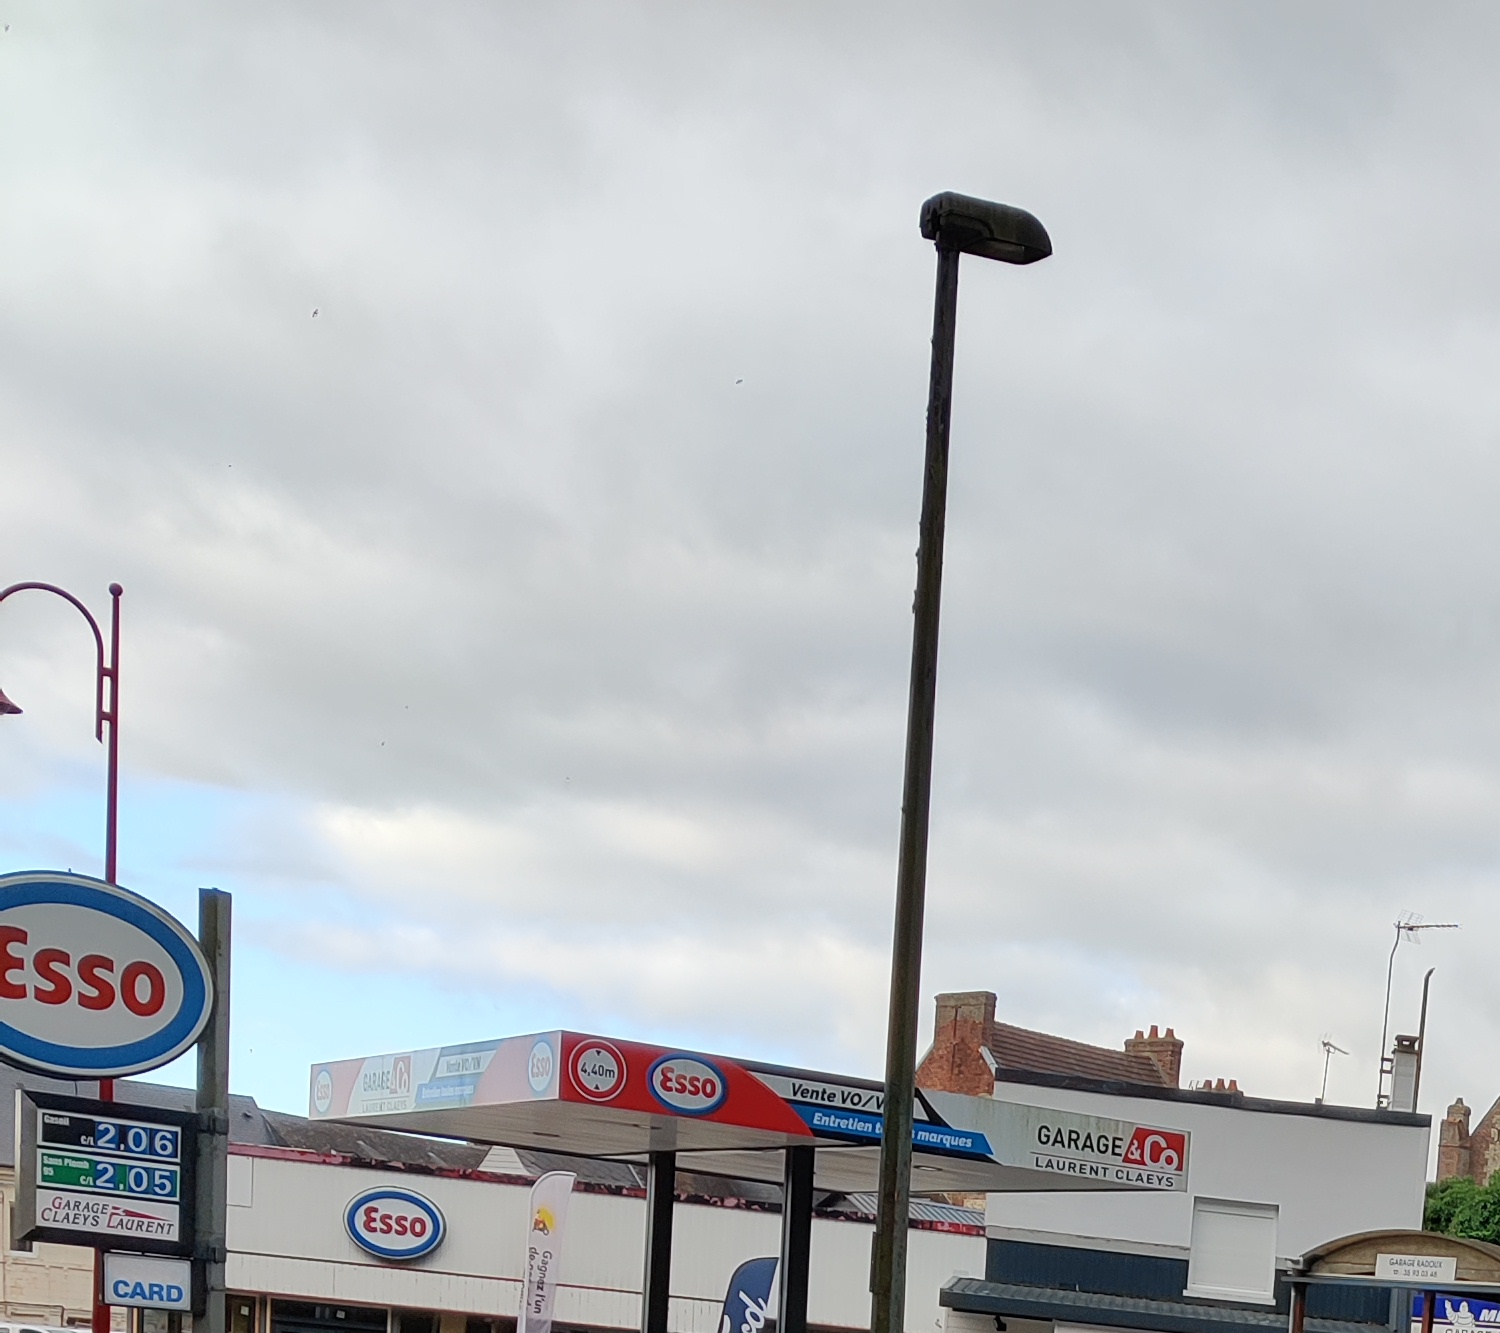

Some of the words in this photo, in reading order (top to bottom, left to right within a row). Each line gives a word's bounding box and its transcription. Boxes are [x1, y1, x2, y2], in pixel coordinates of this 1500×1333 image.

[580, 1062, 616, 1080] 4,40m
[791, 1082, 837, 1103] Vente
[840, 1089, 885, 1110] VO/V
[44, 1114, 70, 1126] Gasoil
[813, 1112, 873, 1133] Entretien
[916, 1130, 973, 1148] marques
[97, 1122, 174, 1156] 2,06
[1037, 1125, 1124, 1158] GARAGE
[43, 1166, 54, 1176] 95
[95, 1163, 173, 1195] 2,05
[1035, 1156, 1110, 1178] LAURENT
[1115, 1169, 1174, 1187] CLAEYS
[52, 1196, 110, 1215] GARAGE
[41, 1208, 100, 1227] CLAEYS
[106, 1213, 175, 1235] LAURENT
[536, 1250, 553, 1291] Gagnez
[1389, 1258, 1415, 1268] GARAGE
[1416, 1260, 1443, 1269] RADOUX
[112, 1280, 184, 1303] CARD
